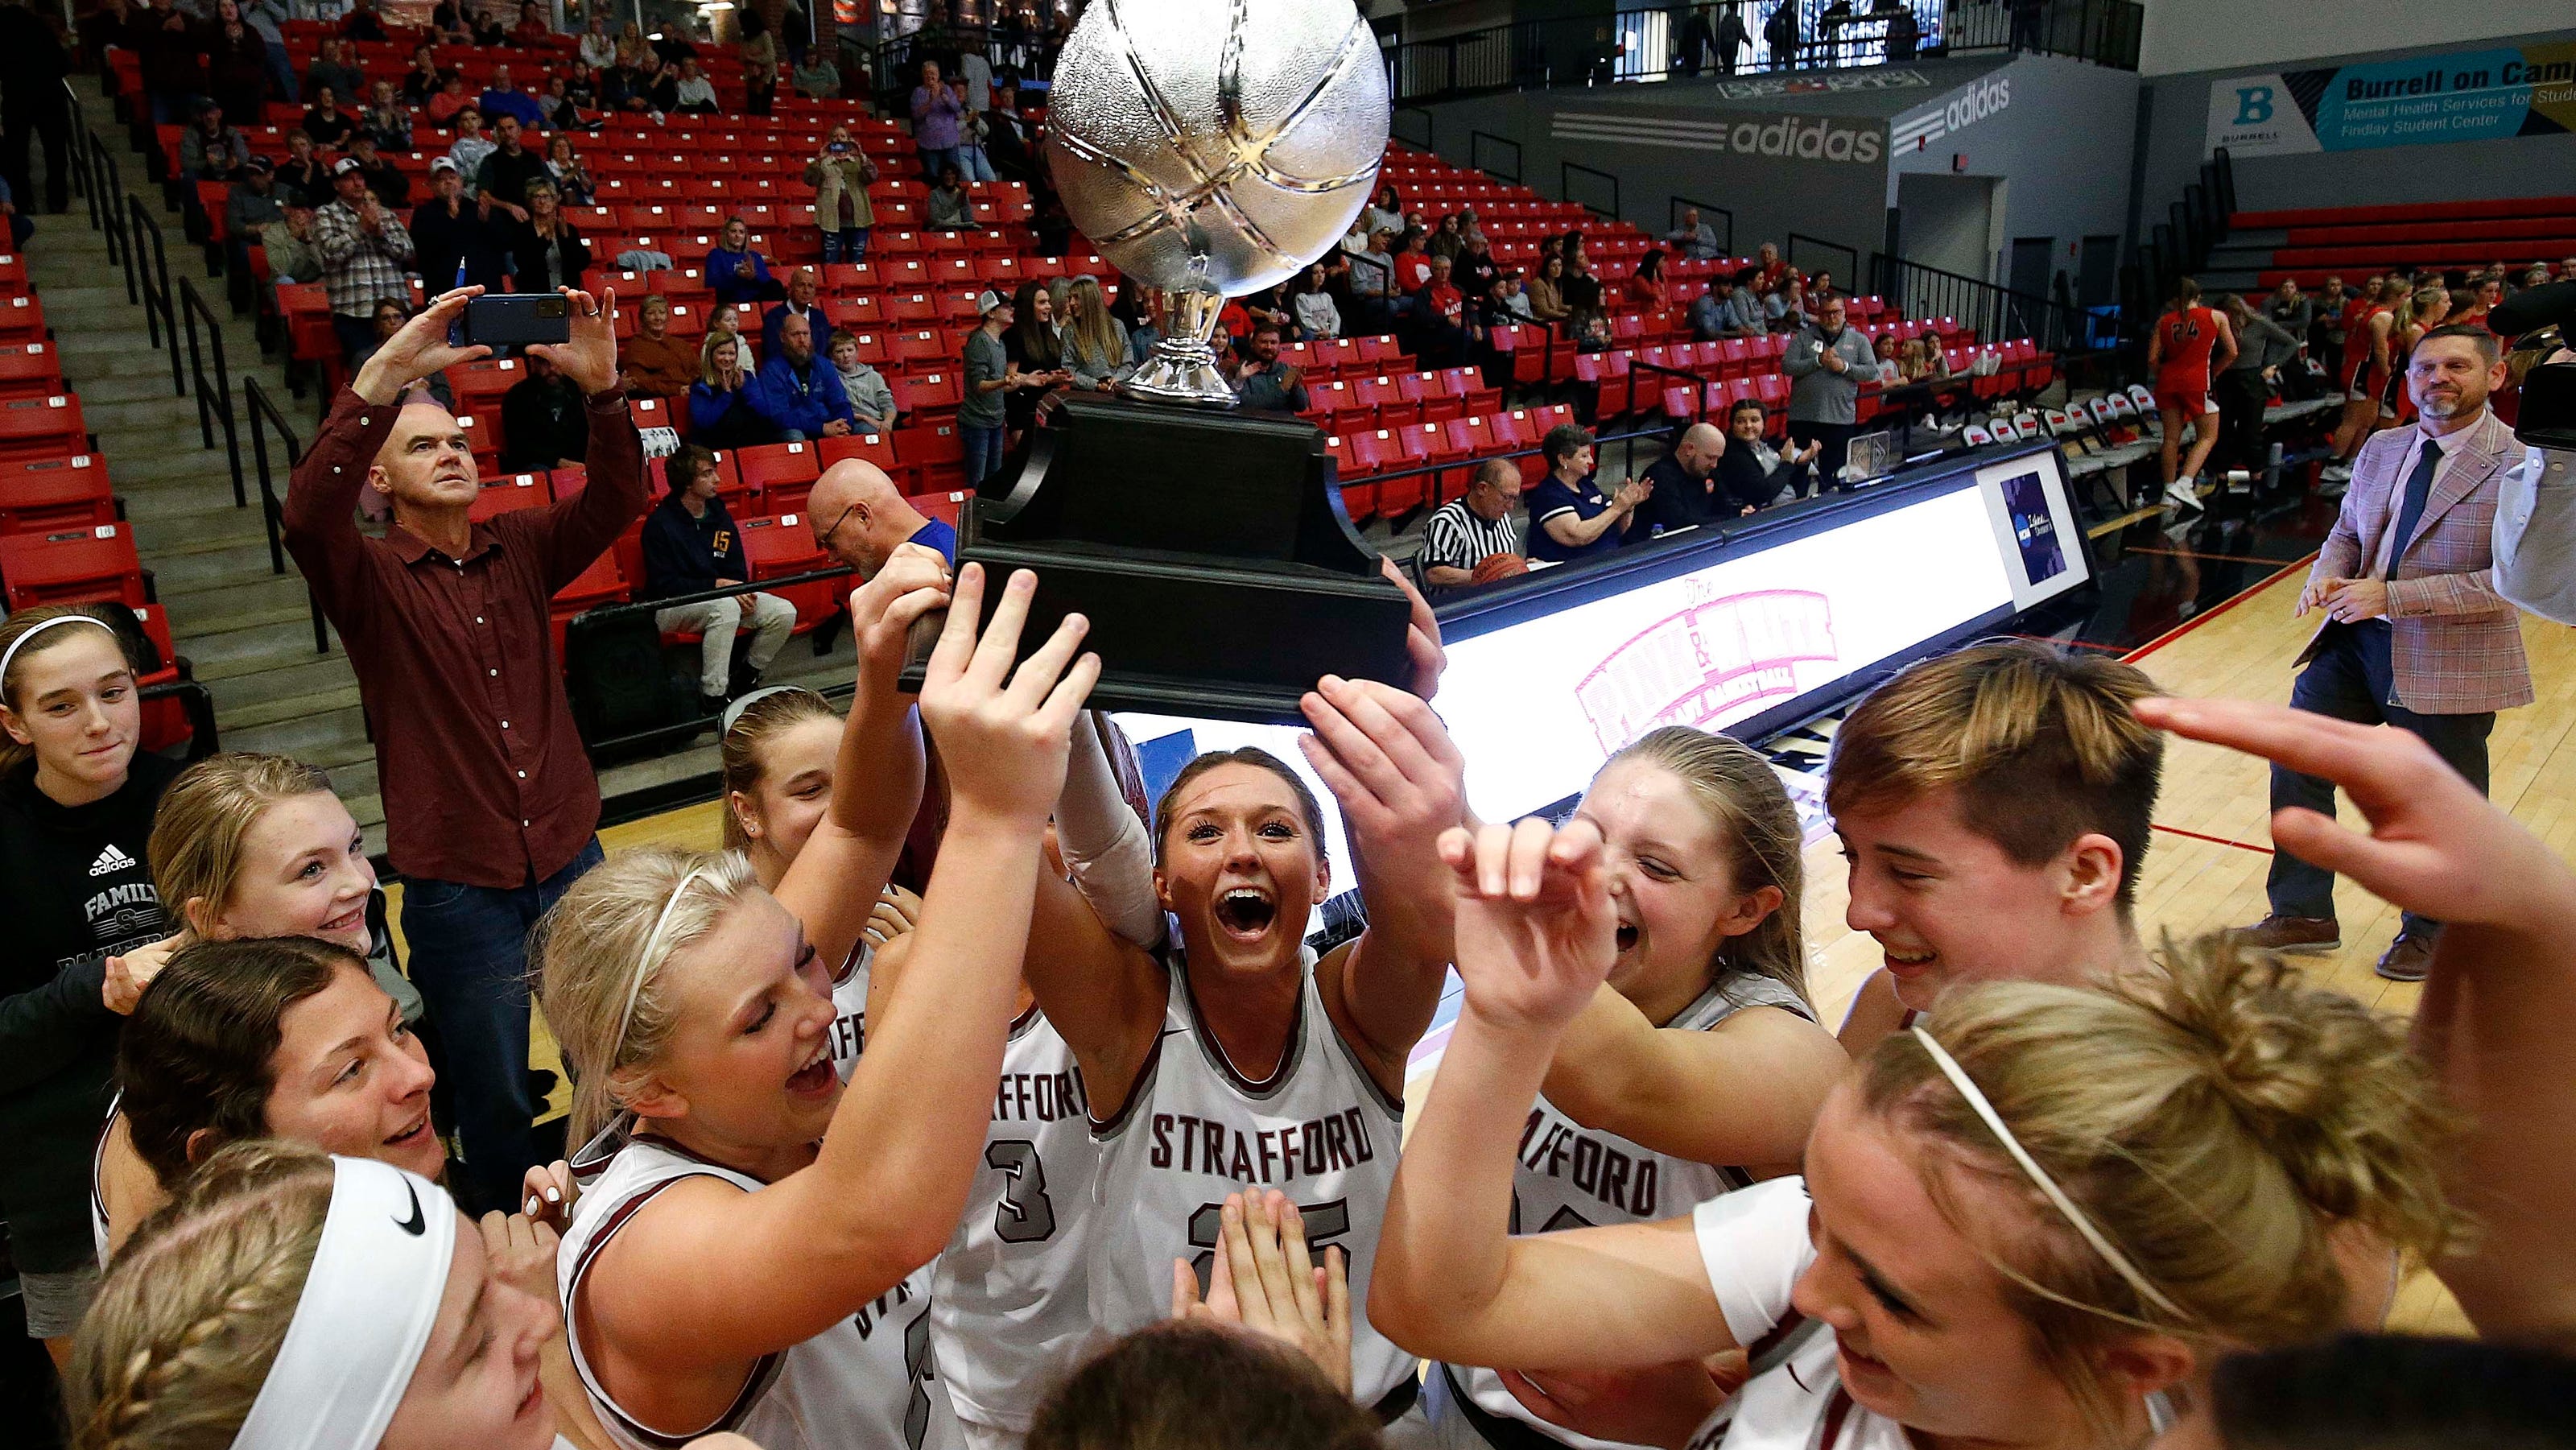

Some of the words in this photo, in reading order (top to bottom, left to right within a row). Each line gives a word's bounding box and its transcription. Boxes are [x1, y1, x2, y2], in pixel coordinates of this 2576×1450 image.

[2347, 70, 2443, 100] Burrell
[2455, 70, 2489, 91] on
[2502, 61, 2576, 85] Cam
[1946, 78, 2010, 131] adidas
[2234, 86, 2273, 125] B
[2343, 106, 2389, 121] Mental
[2395, 102, 2438, 118] Health
[2442, 96, 2505, 113] Services
[2512, 92, 2532, 105] for
[1731, 115, 1881, 162] adidas
[2342, 123, 2388, 137] Findlay
[2394, 117, 2449, 133] Student
[2451, 114, 2499, 129] Center
[712, 531, 731, 552] 15
[89, 857, 136, 877] adidas
[992, 1065, 1088, 1122] FFOR
[1150, 1106, 1373, 1184] STRAFFORD
[984, 1140, 1057, 1243] 3
